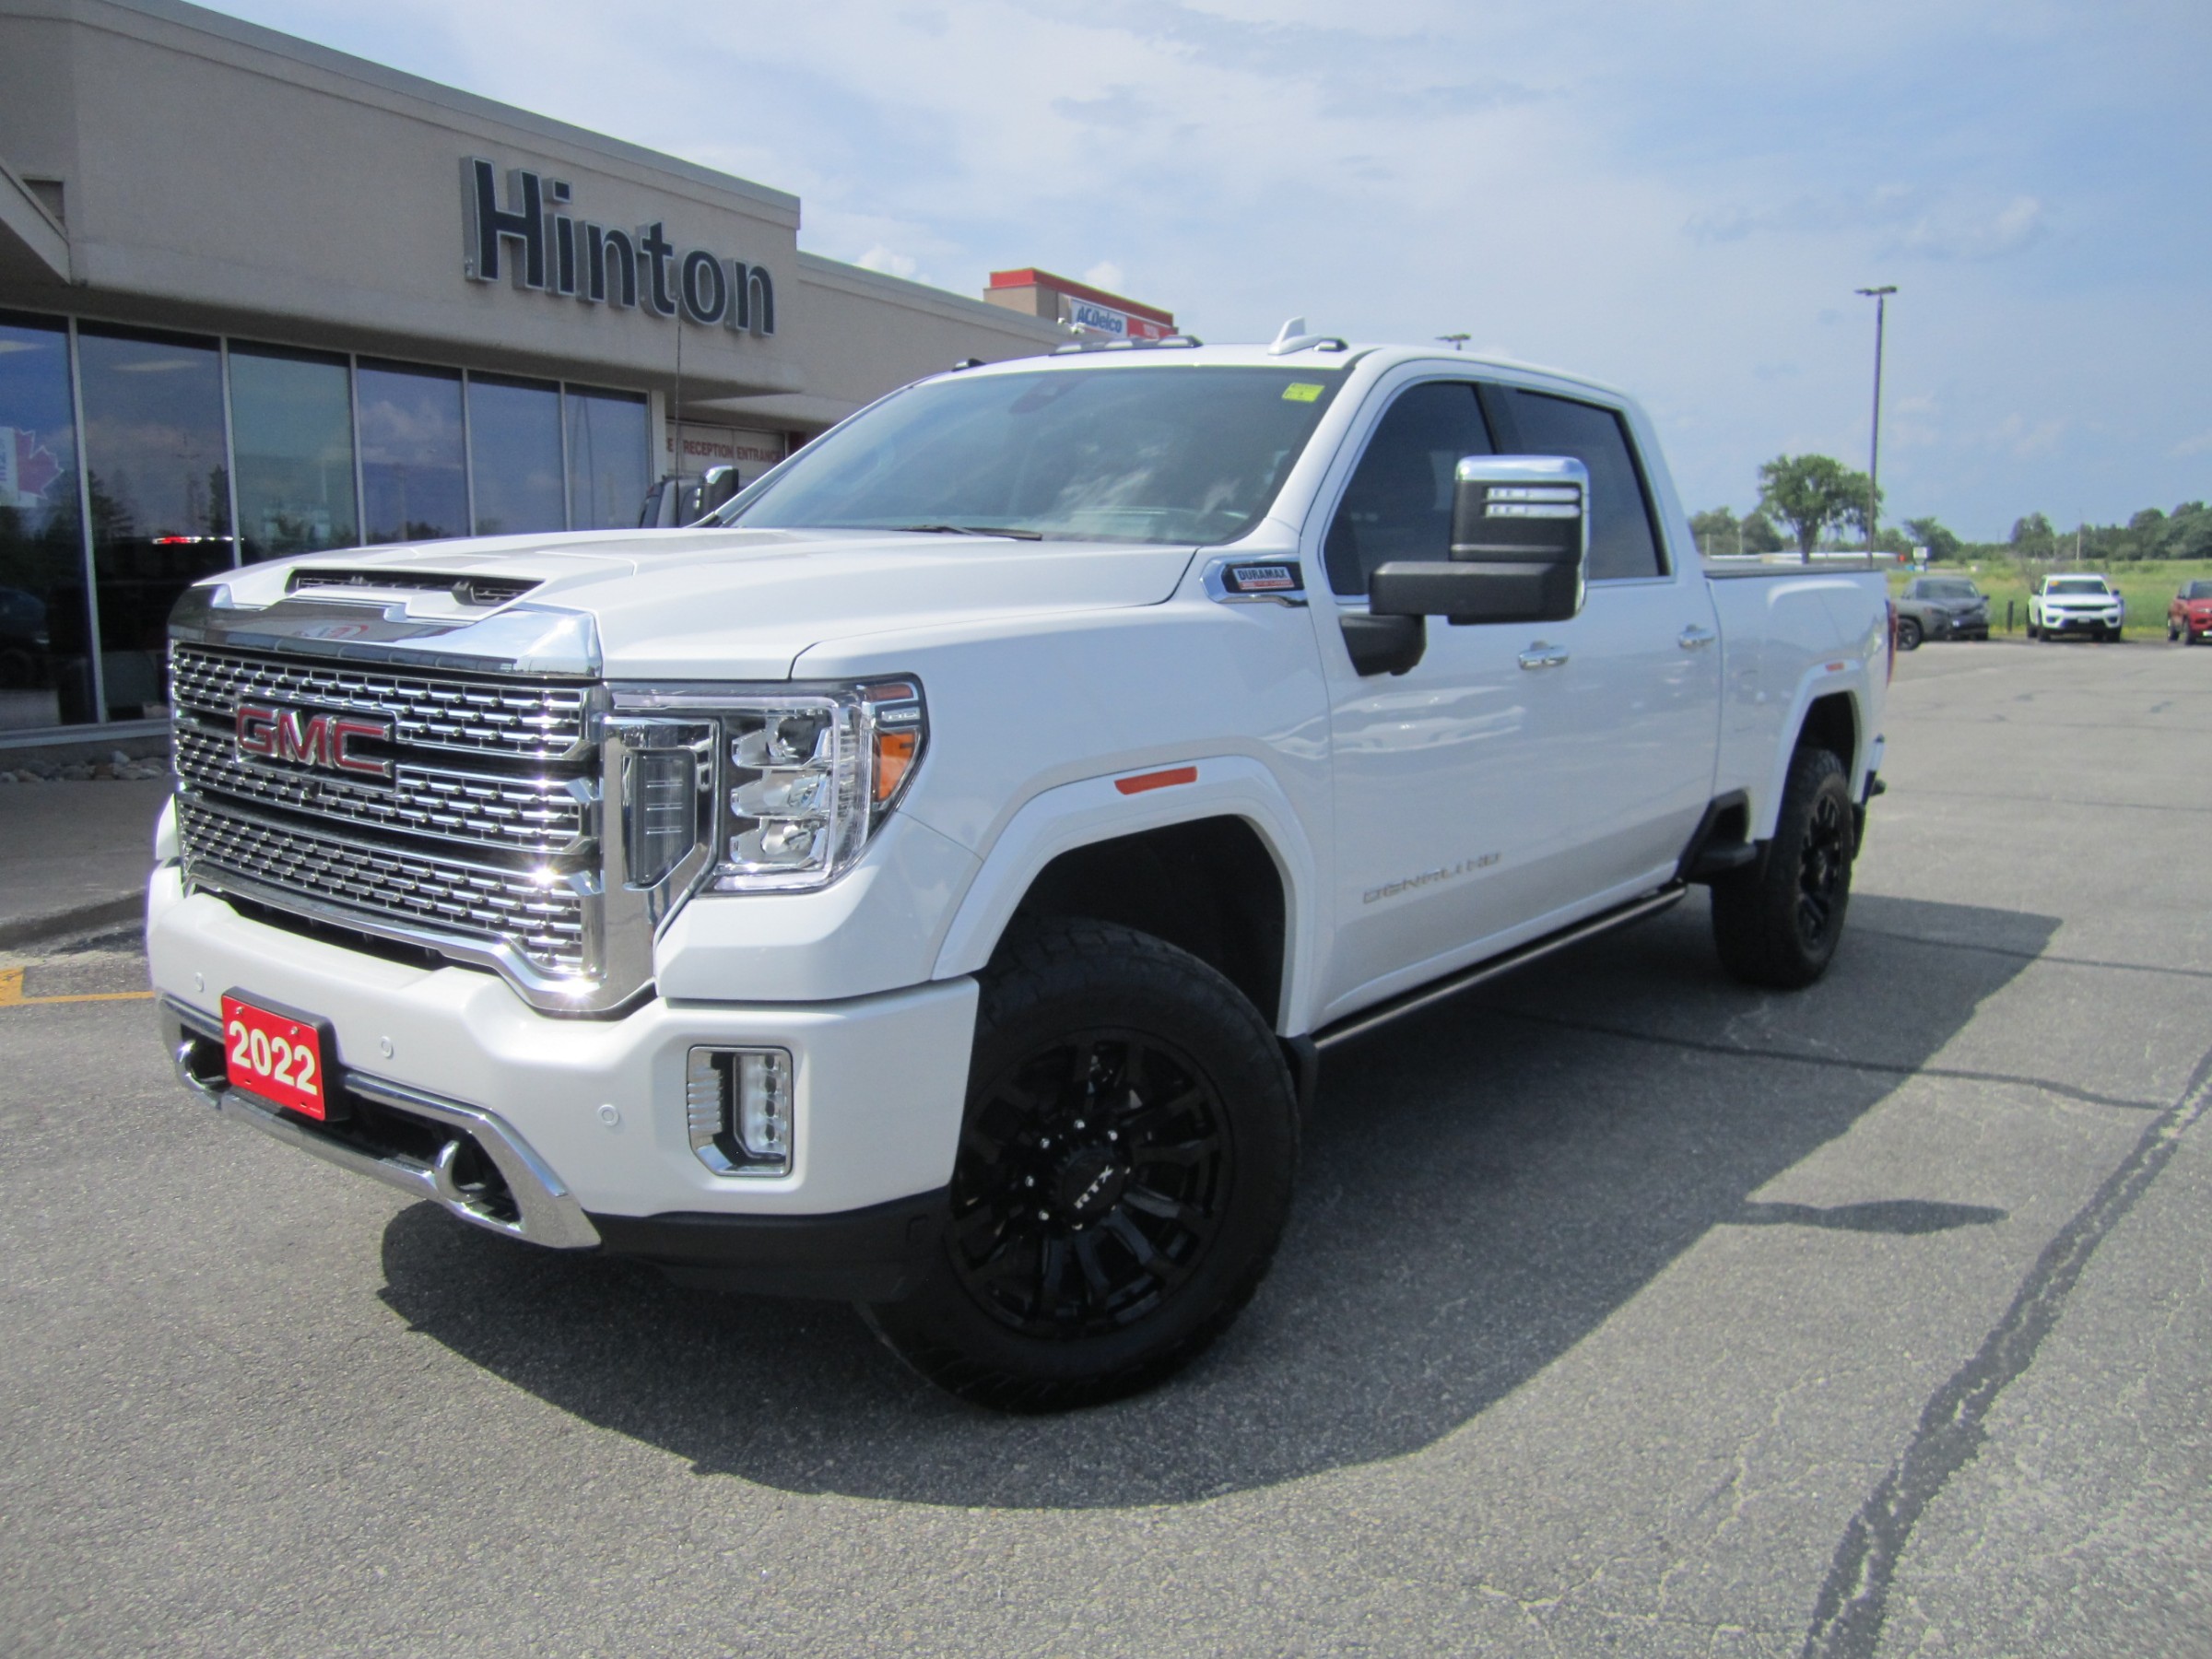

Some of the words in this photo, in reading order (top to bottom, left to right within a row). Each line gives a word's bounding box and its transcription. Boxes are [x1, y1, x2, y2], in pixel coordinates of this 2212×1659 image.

[465, 157, 775, 337] Hinton
[1077, 306, 1123, 334] ACDelco
[683, 439, 734, 459] RECEPTION
[1237, 569, 1288, 581] DURAMAX
[236, 704, 394, 779] GMC
[229, 1020, 318, 1096] 2022
[1074, 1164, 1114, 1209] RTX
